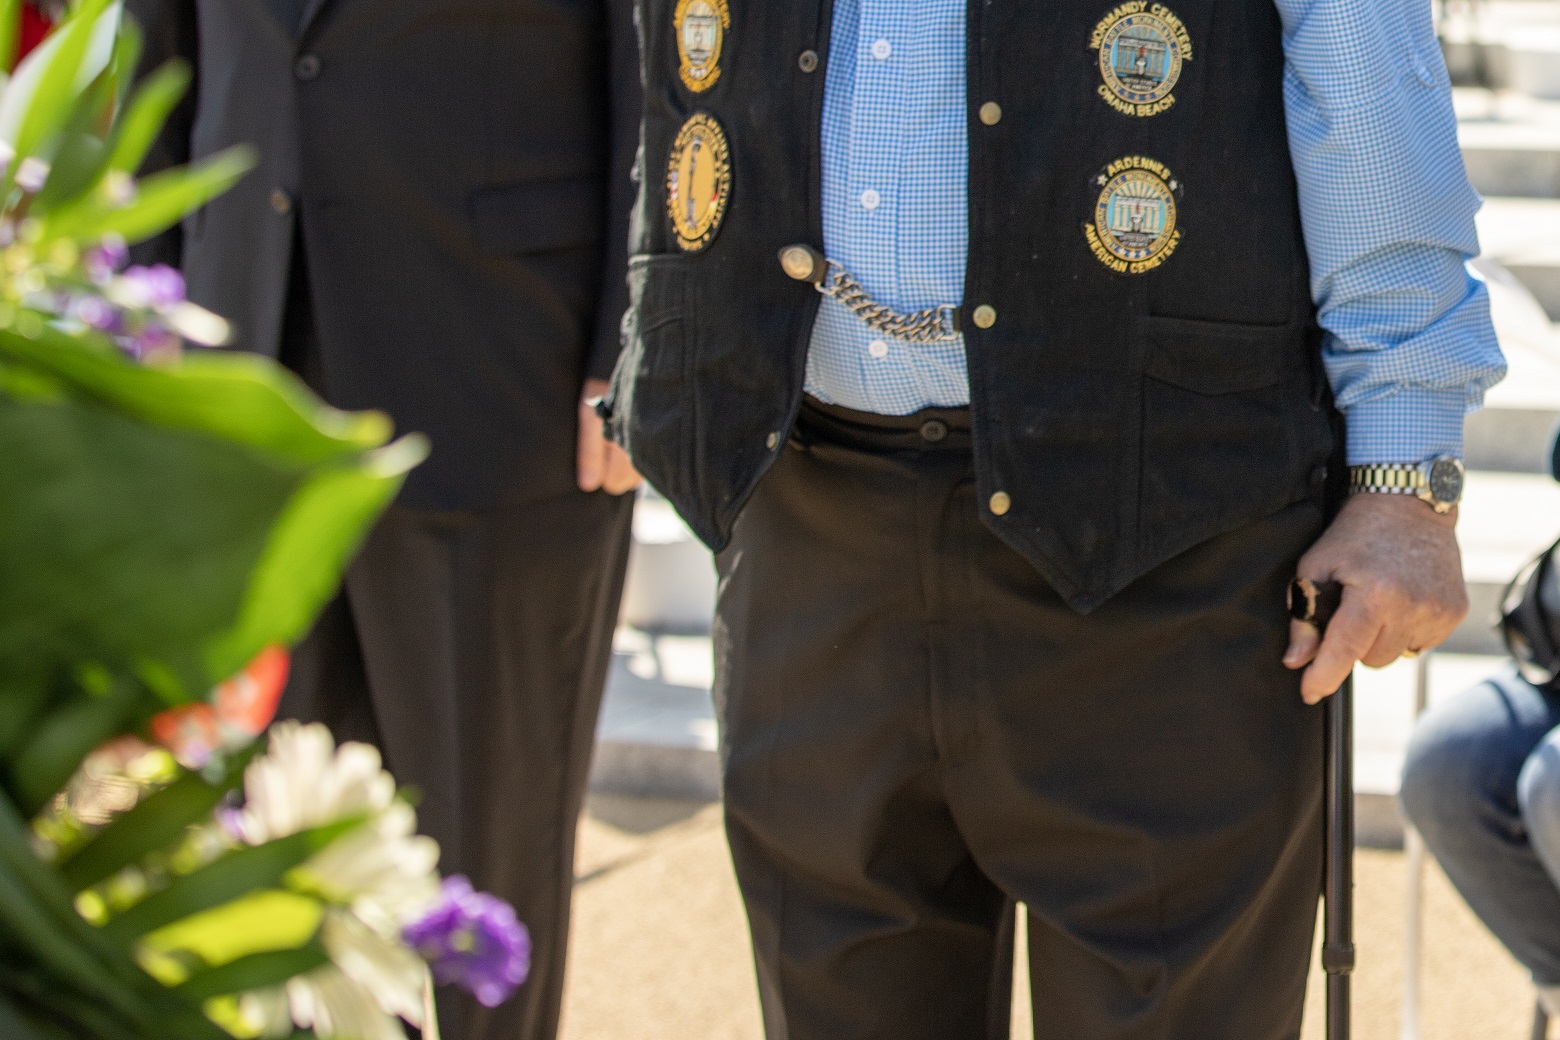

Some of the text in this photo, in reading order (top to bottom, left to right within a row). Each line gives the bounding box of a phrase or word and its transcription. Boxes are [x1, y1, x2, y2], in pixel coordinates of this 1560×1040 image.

[1089, 0, 1193, 61] NORMANDY CEMETERY
[1097, 83, 1136, 116] OMAHA
[1136, 93, 1176, 118] BEACH
[1107, 155, 1172, 181] ARDENNES
[1084, 223, 1182, 274] AMERICAN CEMETERY
